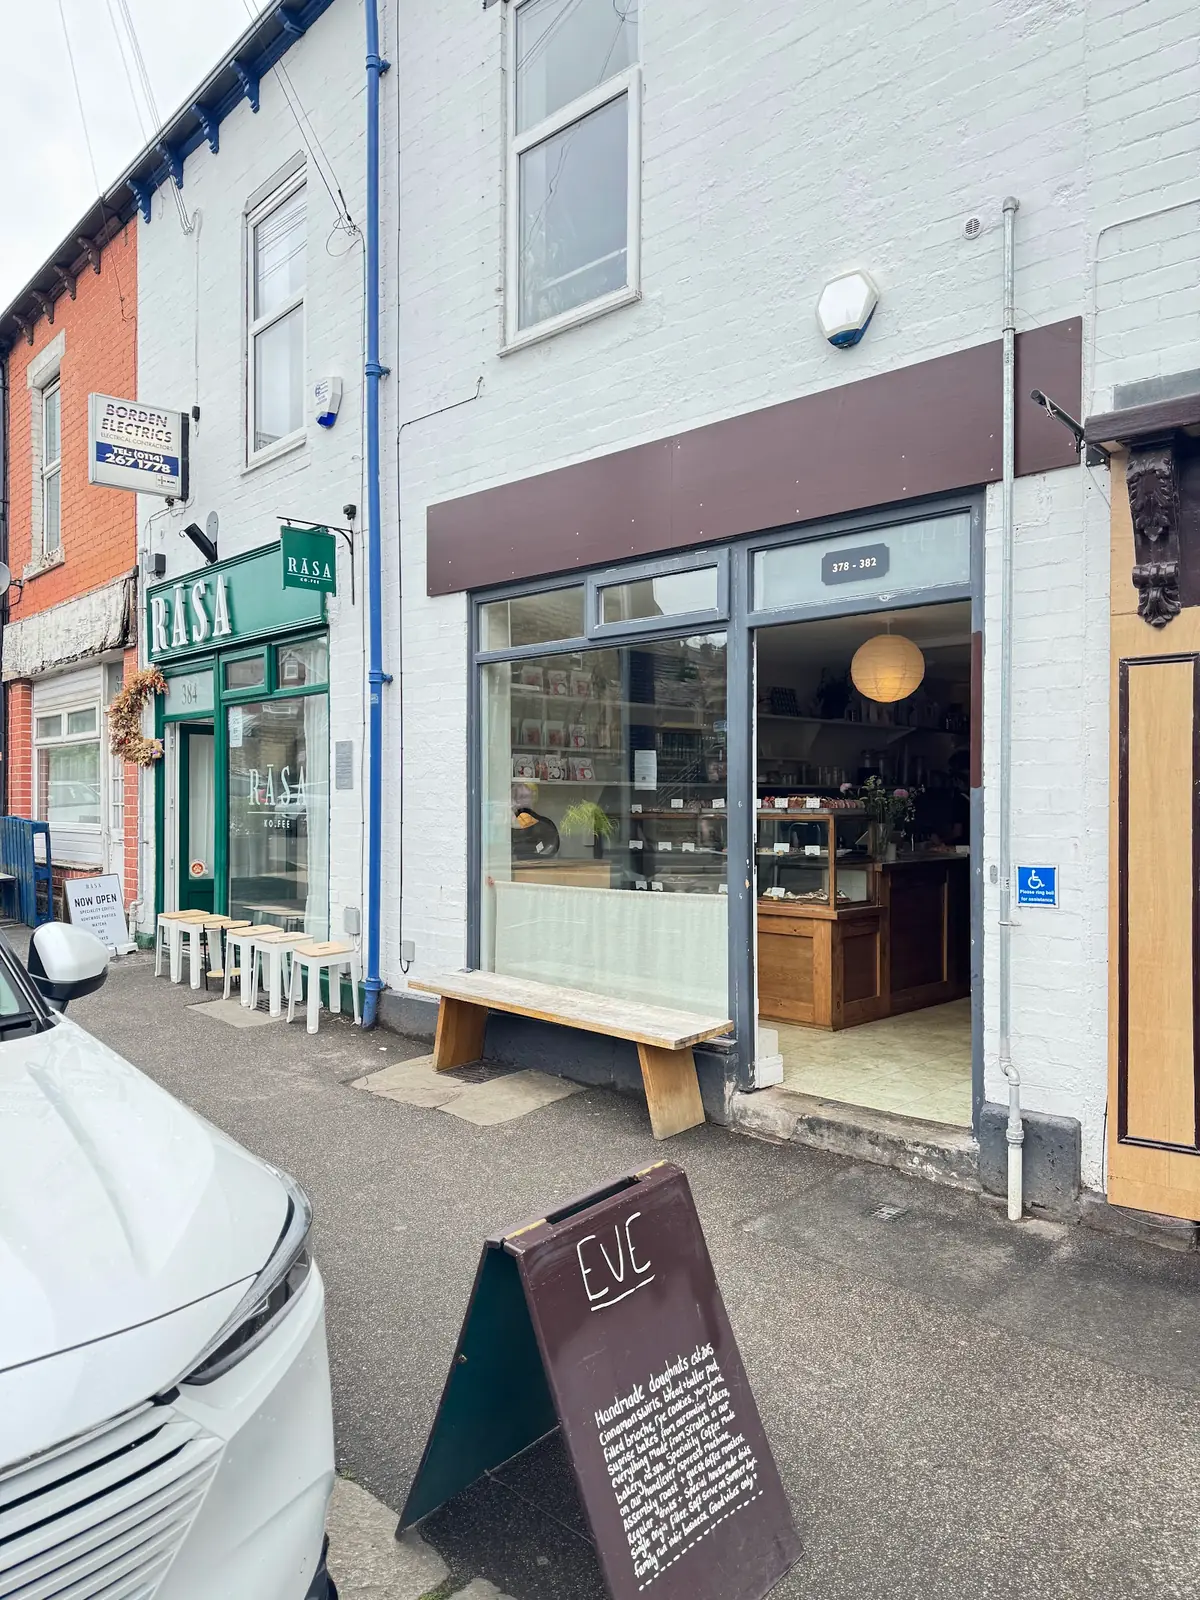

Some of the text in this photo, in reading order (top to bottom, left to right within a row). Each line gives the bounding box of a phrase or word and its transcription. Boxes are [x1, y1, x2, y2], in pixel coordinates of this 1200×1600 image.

[106, 403, 168, 428] BORDEN
[100, 431, 174, 452] ELECTRICAL CONTRACTORS
[101, 417, 173, 443] ELECTRICS
[134, 448, 164, 463] (0114)
[832, 561, 849, 573] 378
[859, 557, 877, 568] 382
[150, 574, 232, 653] RĀSA
[181, 682, 198, 705] 384
[74, 893, 117, 908] NOW OPEN
[577, 1212, 651, 1301] EVE
[594, 1384, 645, 1428] Handmade
[649, 1355, 688, 1392] doughnuts
[599, 1413, 637, 1445] Cinnamon
[635, 1431, 659, 1454] bakes
[660, 1423, 676, 1441] from
[675, 1414, 686, 1427] our
[611, 1455, 650, 1488] everything
[668, 1430, 687, 1450] from
[710, 1409, 717, 1418] in
[718, 1400, 729, 1414] our
[615, 1478, 644, 1504] bakery
[665, 1436, 700, 1465] Speciality
[623, 1498, 660, 1530] Assembly
[658, 1480, 678, 1502] roast
[686, 1460, 705, 1486] guest
[718, 1479, 726, 1490] on
[619, 1504, 630, 1516] on
[630, 1494, 641, 1509] our
[656, 1544, 668, 1557] run
[723, 1485, 739, 1502] vibes
[740, 1474, 753, 1490] only
[627, 1518, 653, 1546] Regular
